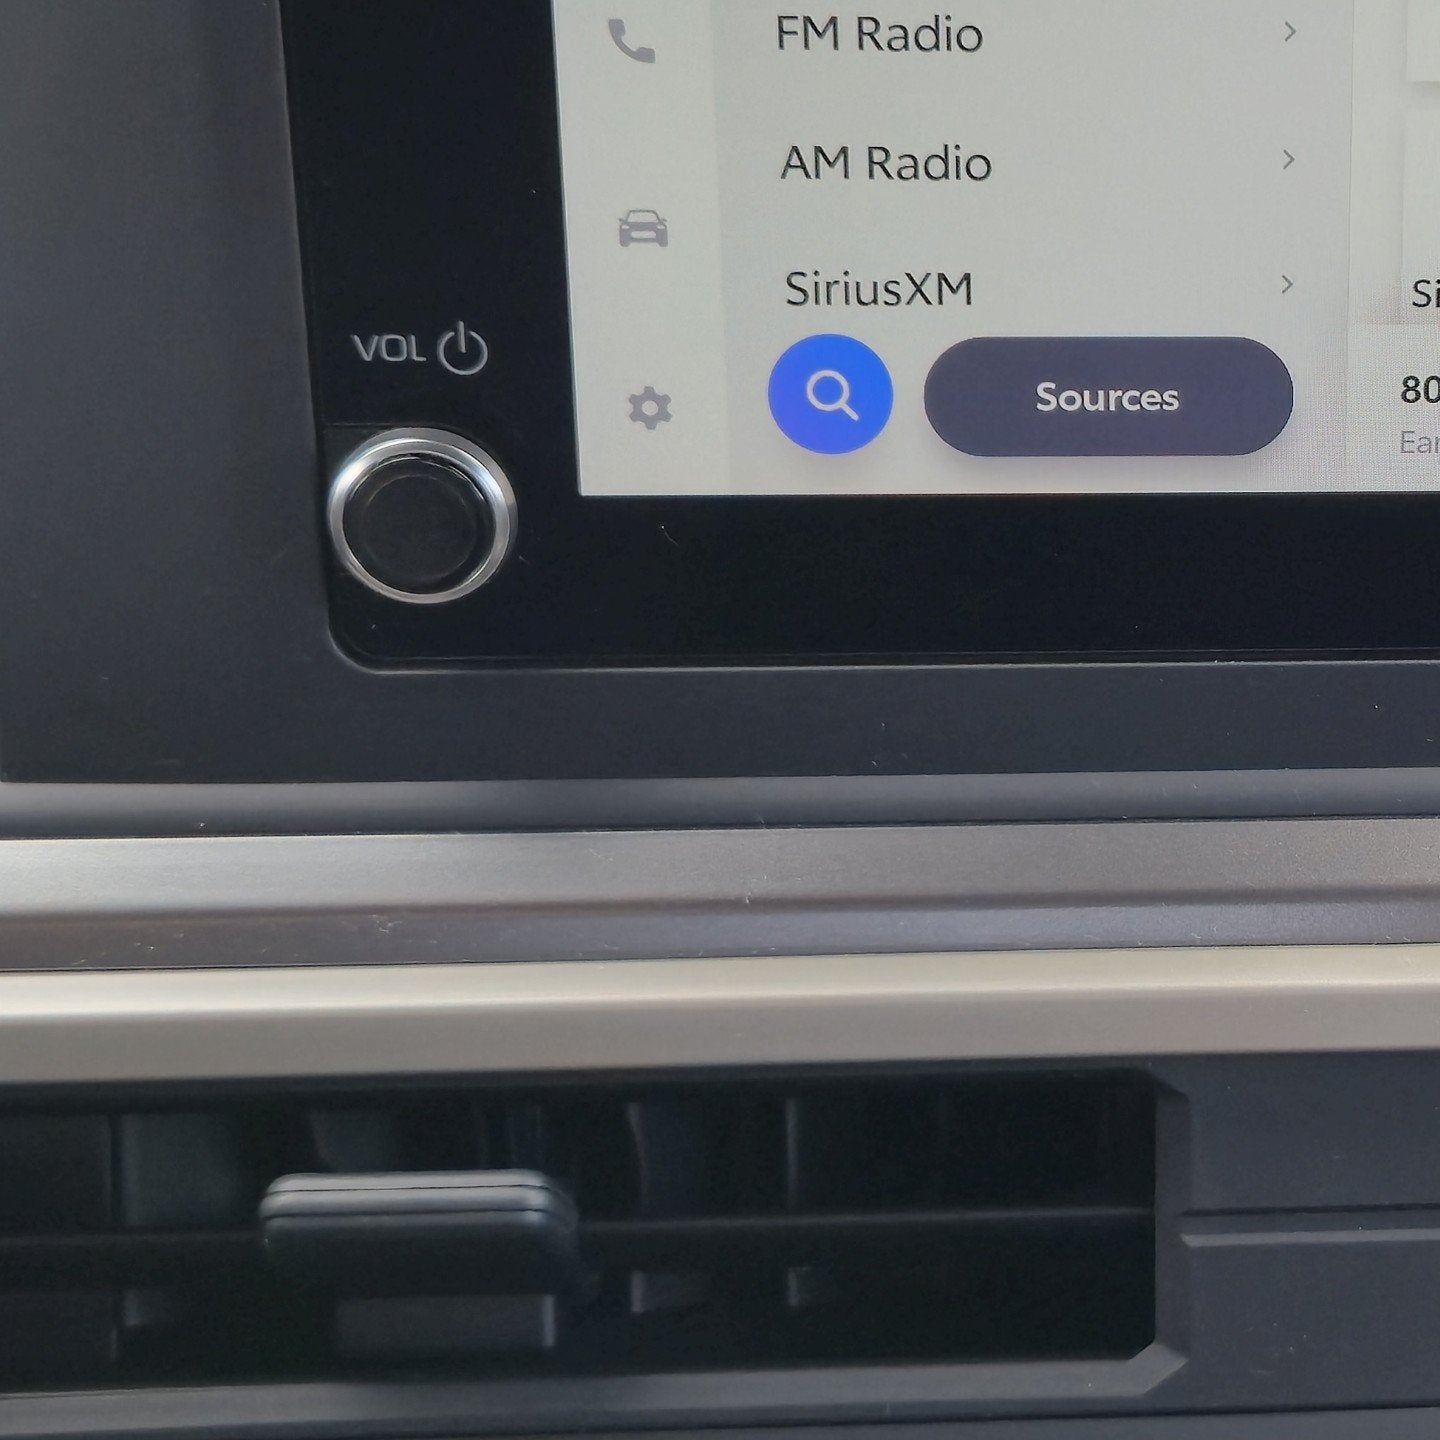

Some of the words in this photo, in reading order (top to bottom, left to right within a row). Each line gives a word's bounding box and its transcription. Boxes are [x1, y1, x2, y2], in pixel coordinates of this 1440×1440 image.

[776, 15, 840, 52] FM
[857, 14, 985, 53] Radio
[780, 145, 851, 181] AM
[867, 144, 992, 182] Radio
[785, 270, 974, 307] SiriusXM
[350, 334, 427, 362] VOL
[1035, 382, 1180, 413] Sources
